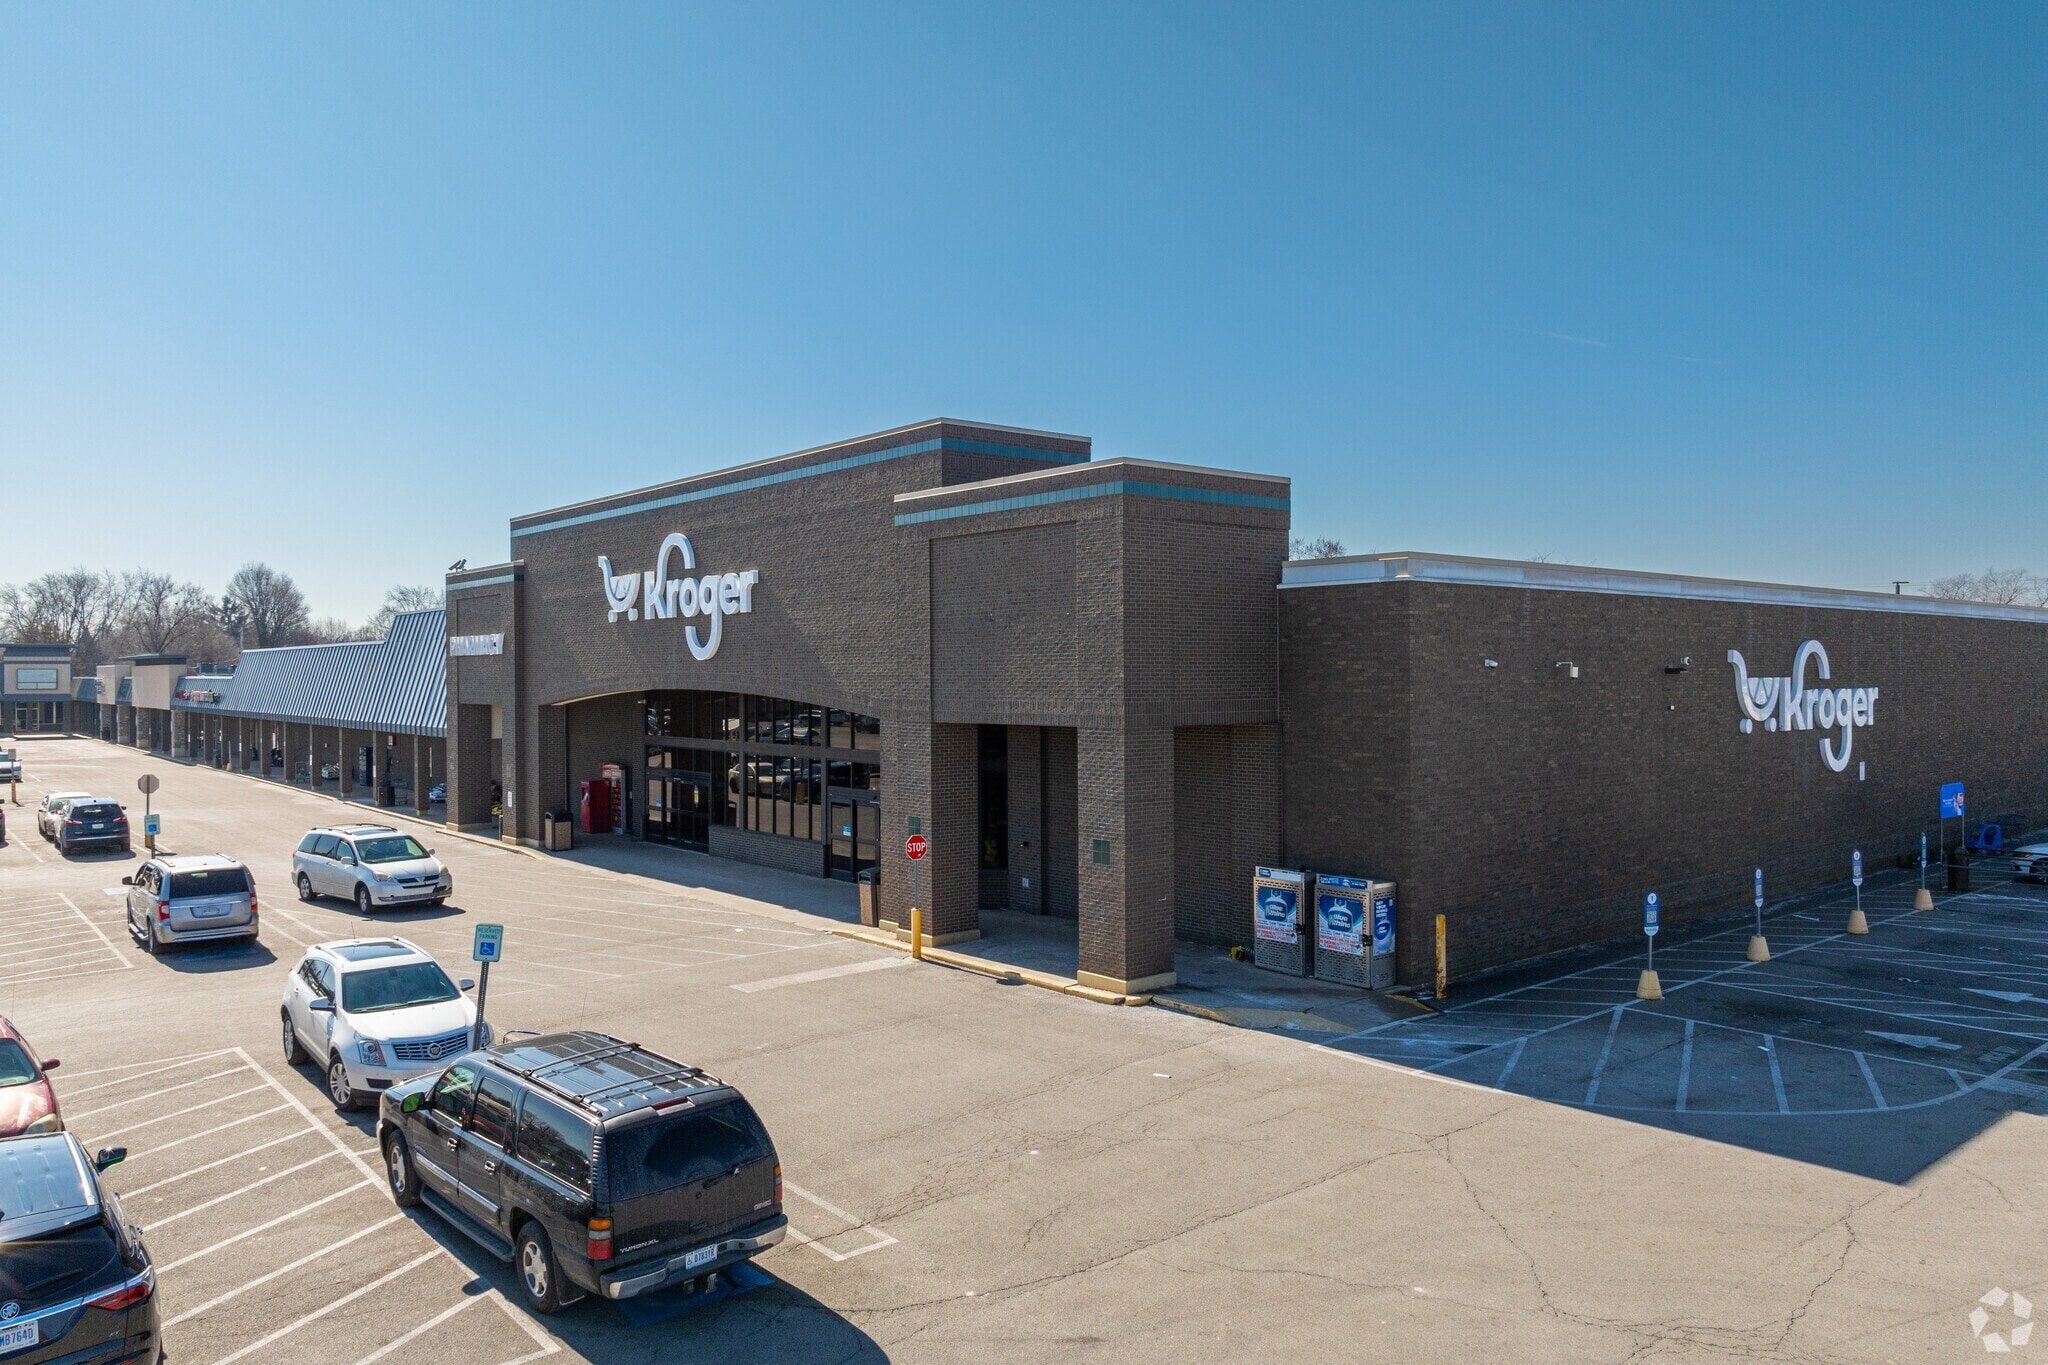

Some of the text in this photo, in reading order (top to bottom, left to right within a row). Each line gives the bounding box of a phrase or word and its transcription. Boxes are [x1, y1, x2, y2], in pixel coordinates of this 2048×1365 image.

[644, 532, 759, 661] Kroger
[1779, 640, 1879, 773] Kroger
[907, 842, 926, 852] STOP
[620, 1238, 659, 1253] YUKON XL
